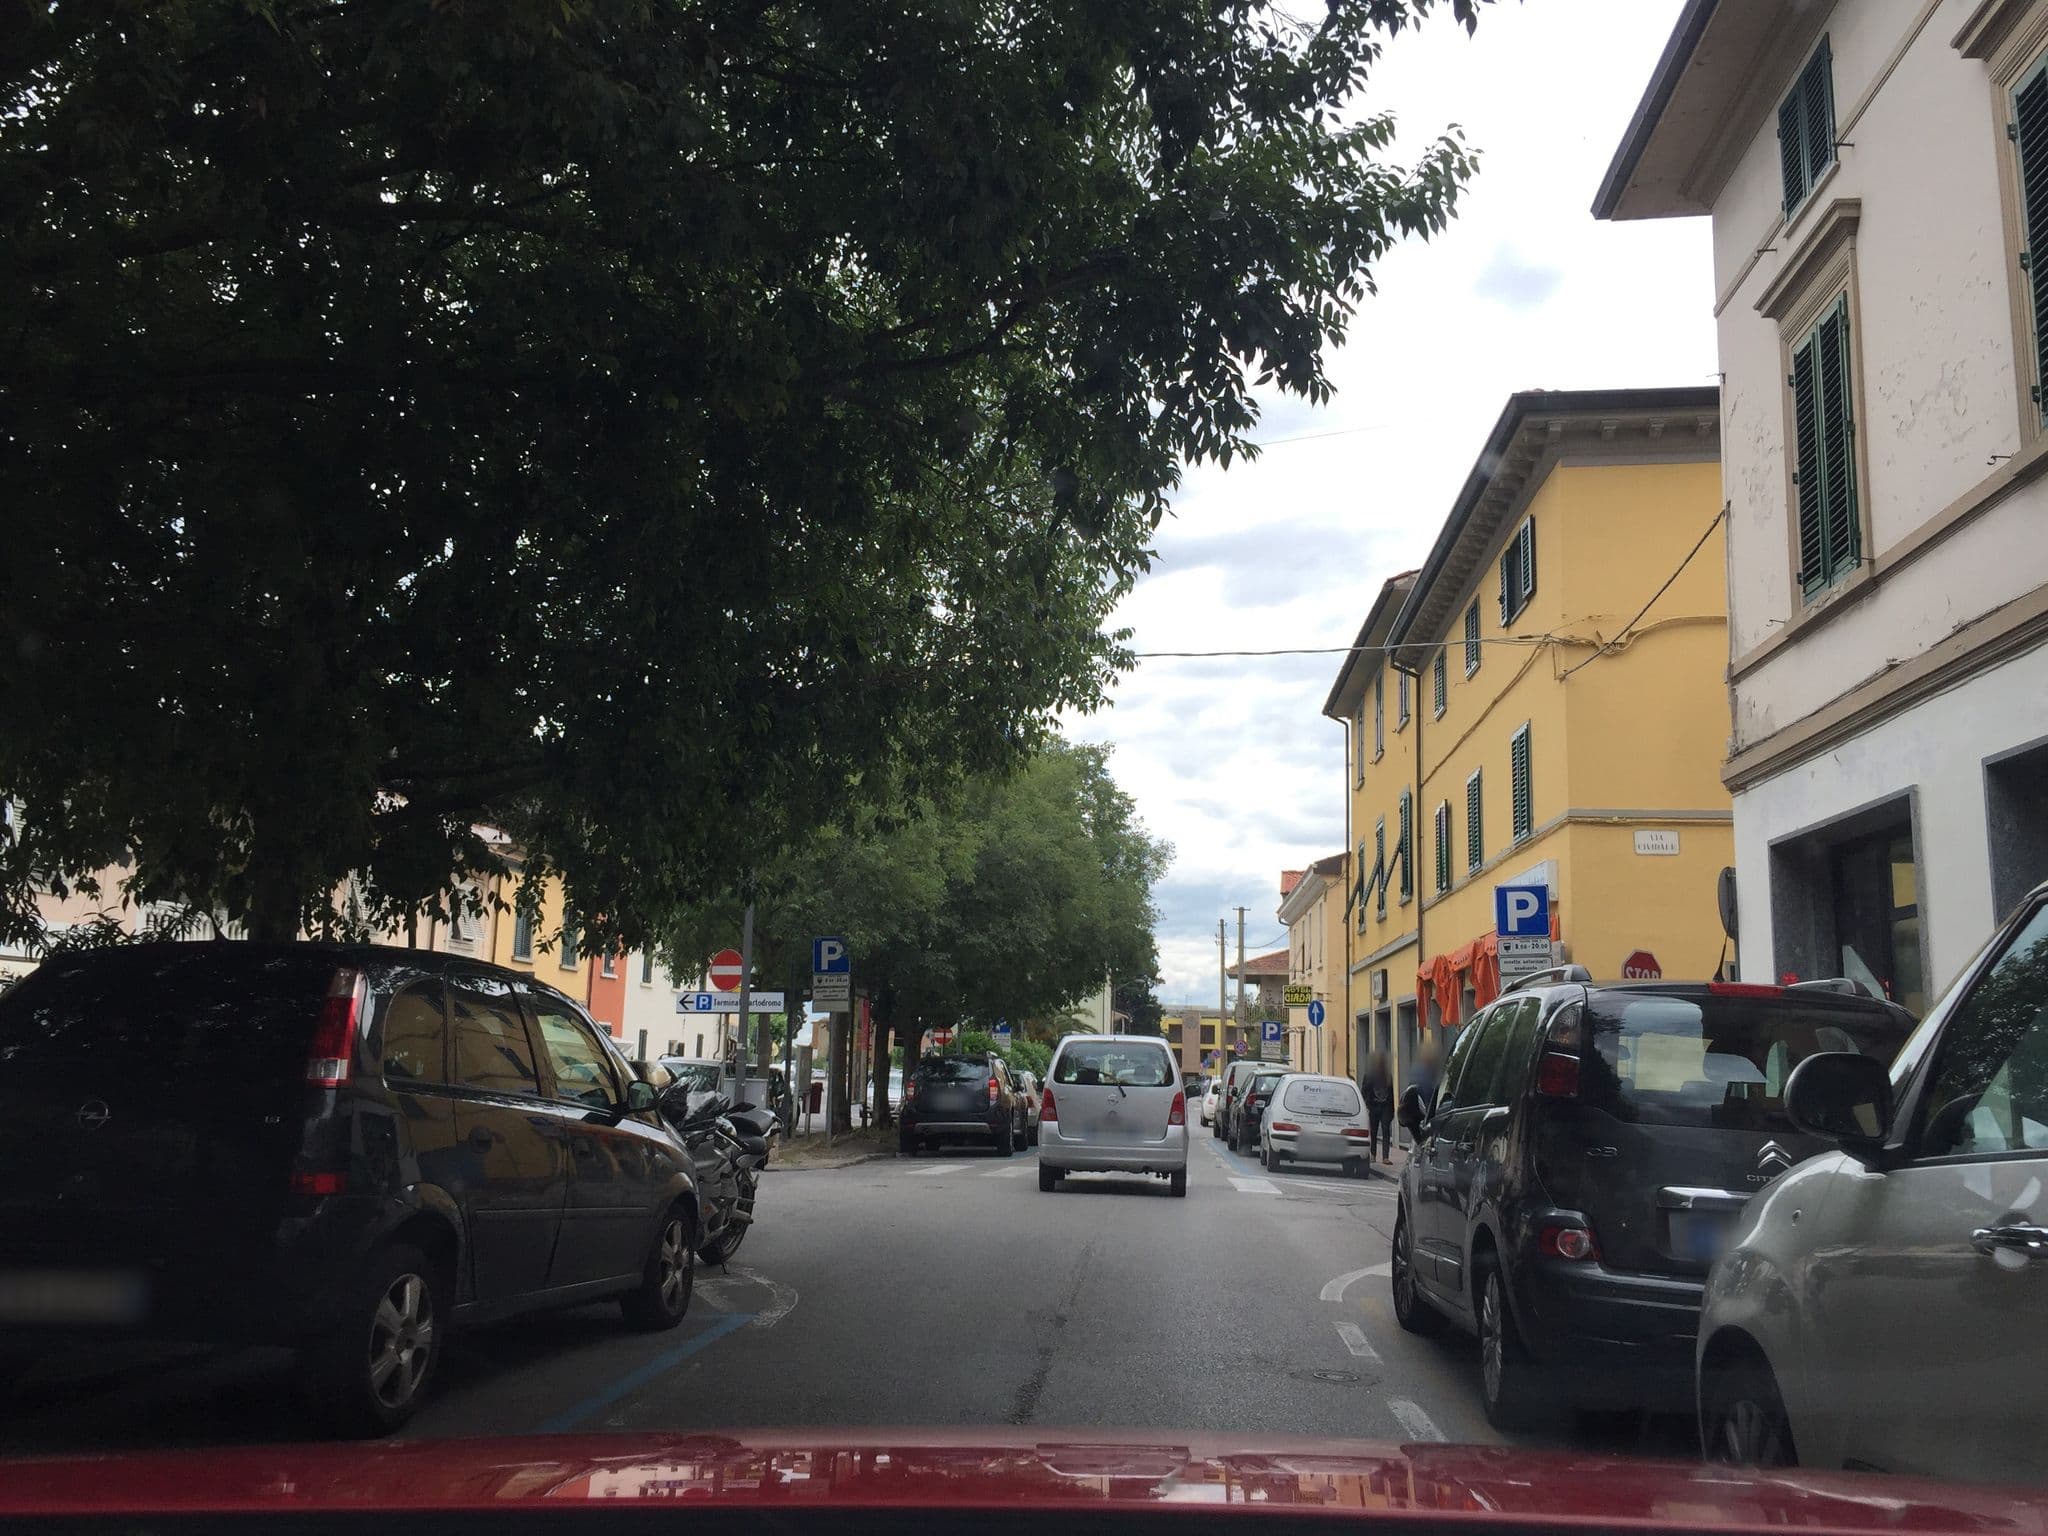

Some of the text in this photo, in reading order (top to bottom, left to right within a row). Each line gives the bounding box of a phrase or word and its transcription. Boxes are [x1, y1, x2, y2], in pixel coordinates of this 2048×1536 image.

[1506, 891, 1540, 932] P
[820, 940, 844, 970] P
[1266, 1023, 1279, 1039] P
